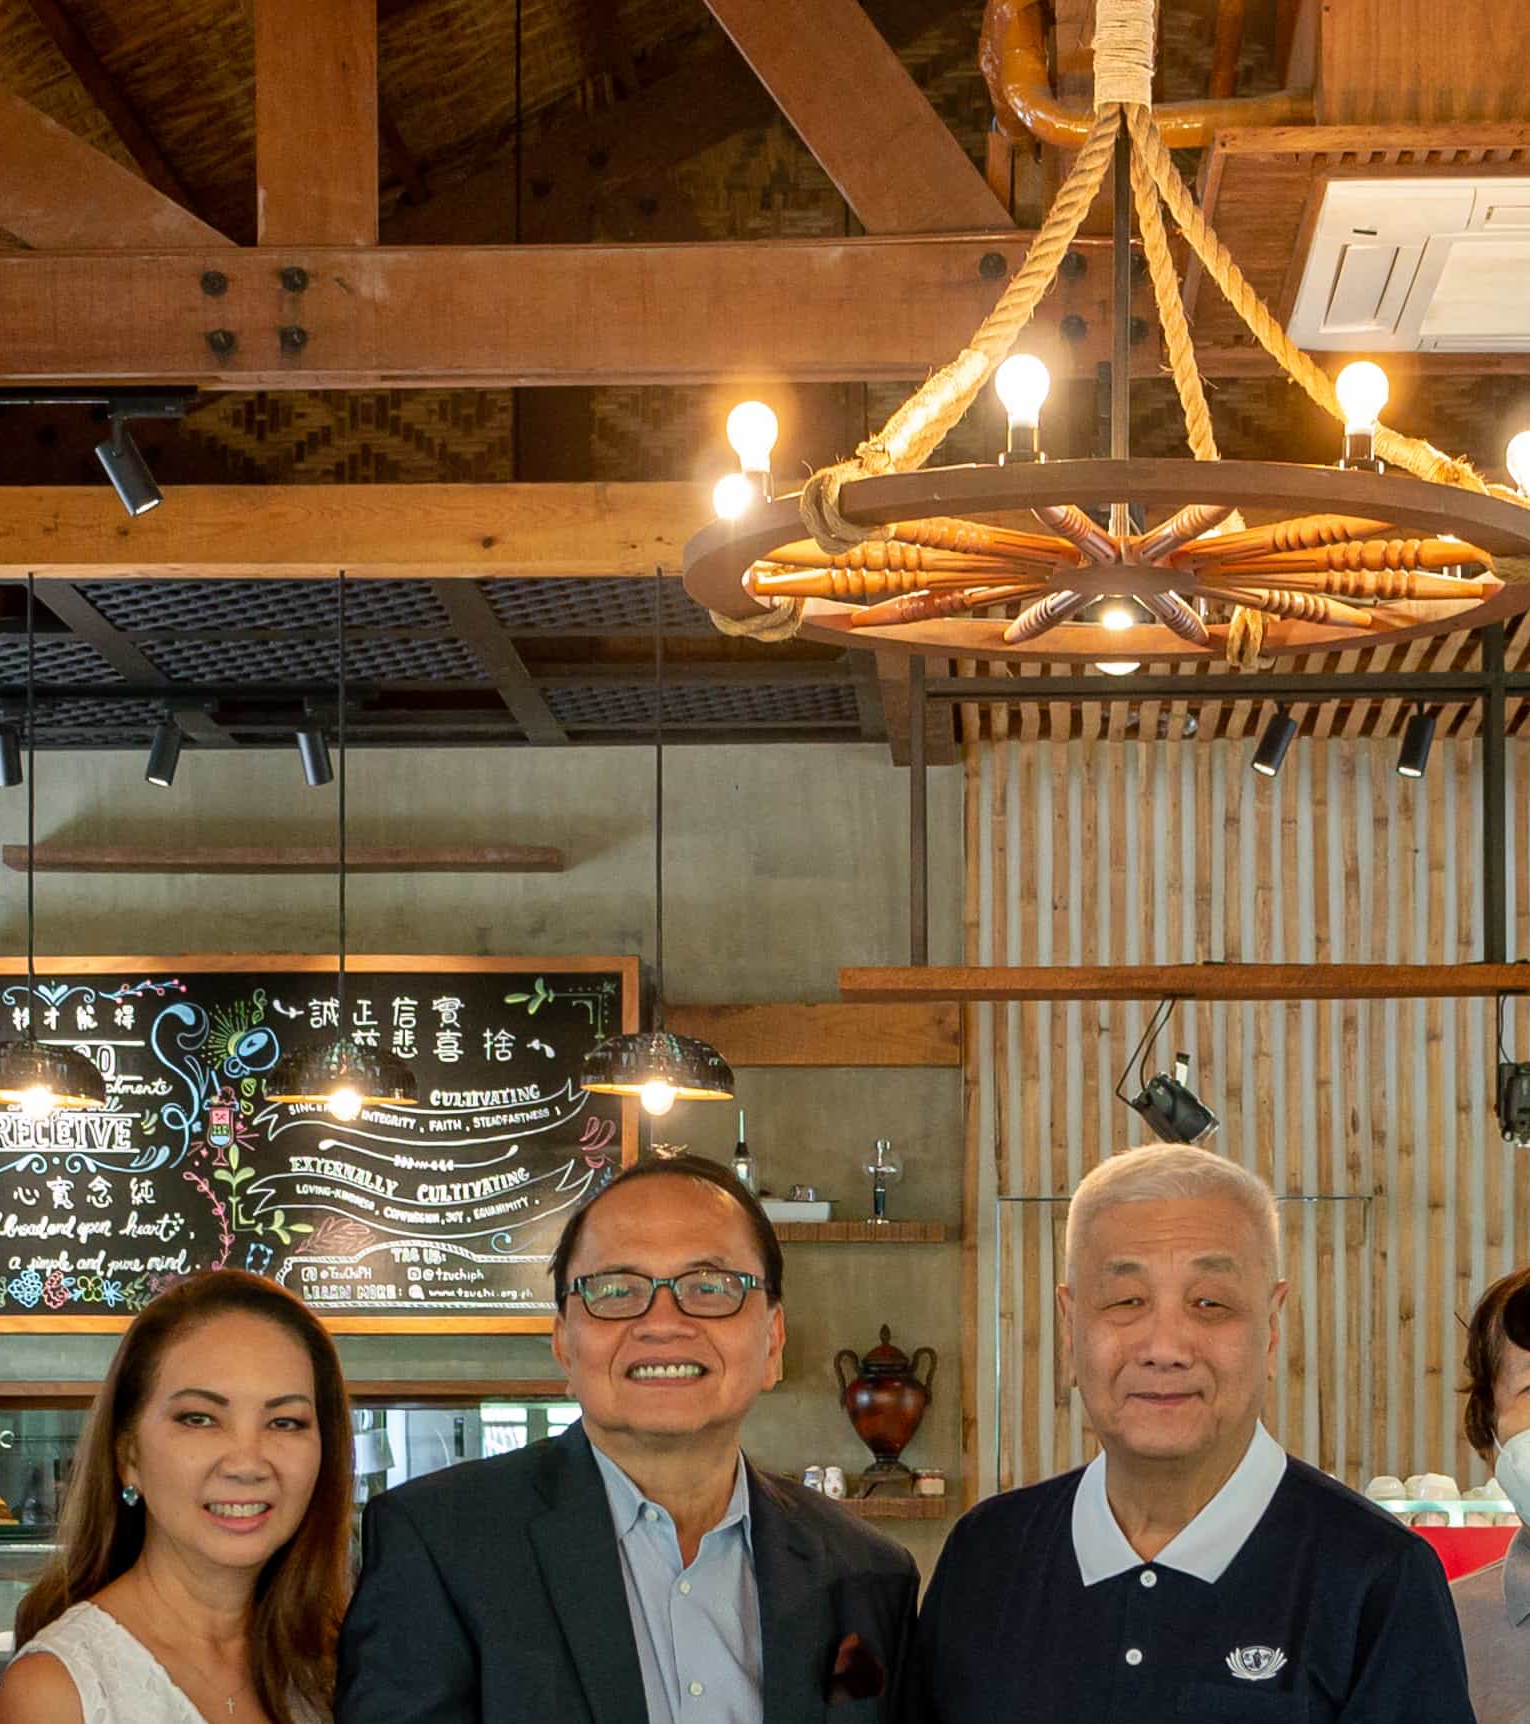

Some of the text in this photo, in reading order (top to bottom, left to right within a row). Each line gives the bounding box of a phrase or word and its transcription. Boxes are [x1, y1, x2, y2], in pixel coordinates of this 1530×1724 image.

[429, 1084, 541, 1107] CULTIVATING
[289, 1156, 531, 1202] EXTERNALLY CULTIVATING
[77, 1217, 112, 1244] open
[8, 1256, 21, 1270] a
[26, 1250, 75, 1276] simple
[76, 1250, 106, 1276] and
[107, 1257, 144, 1278] pure
